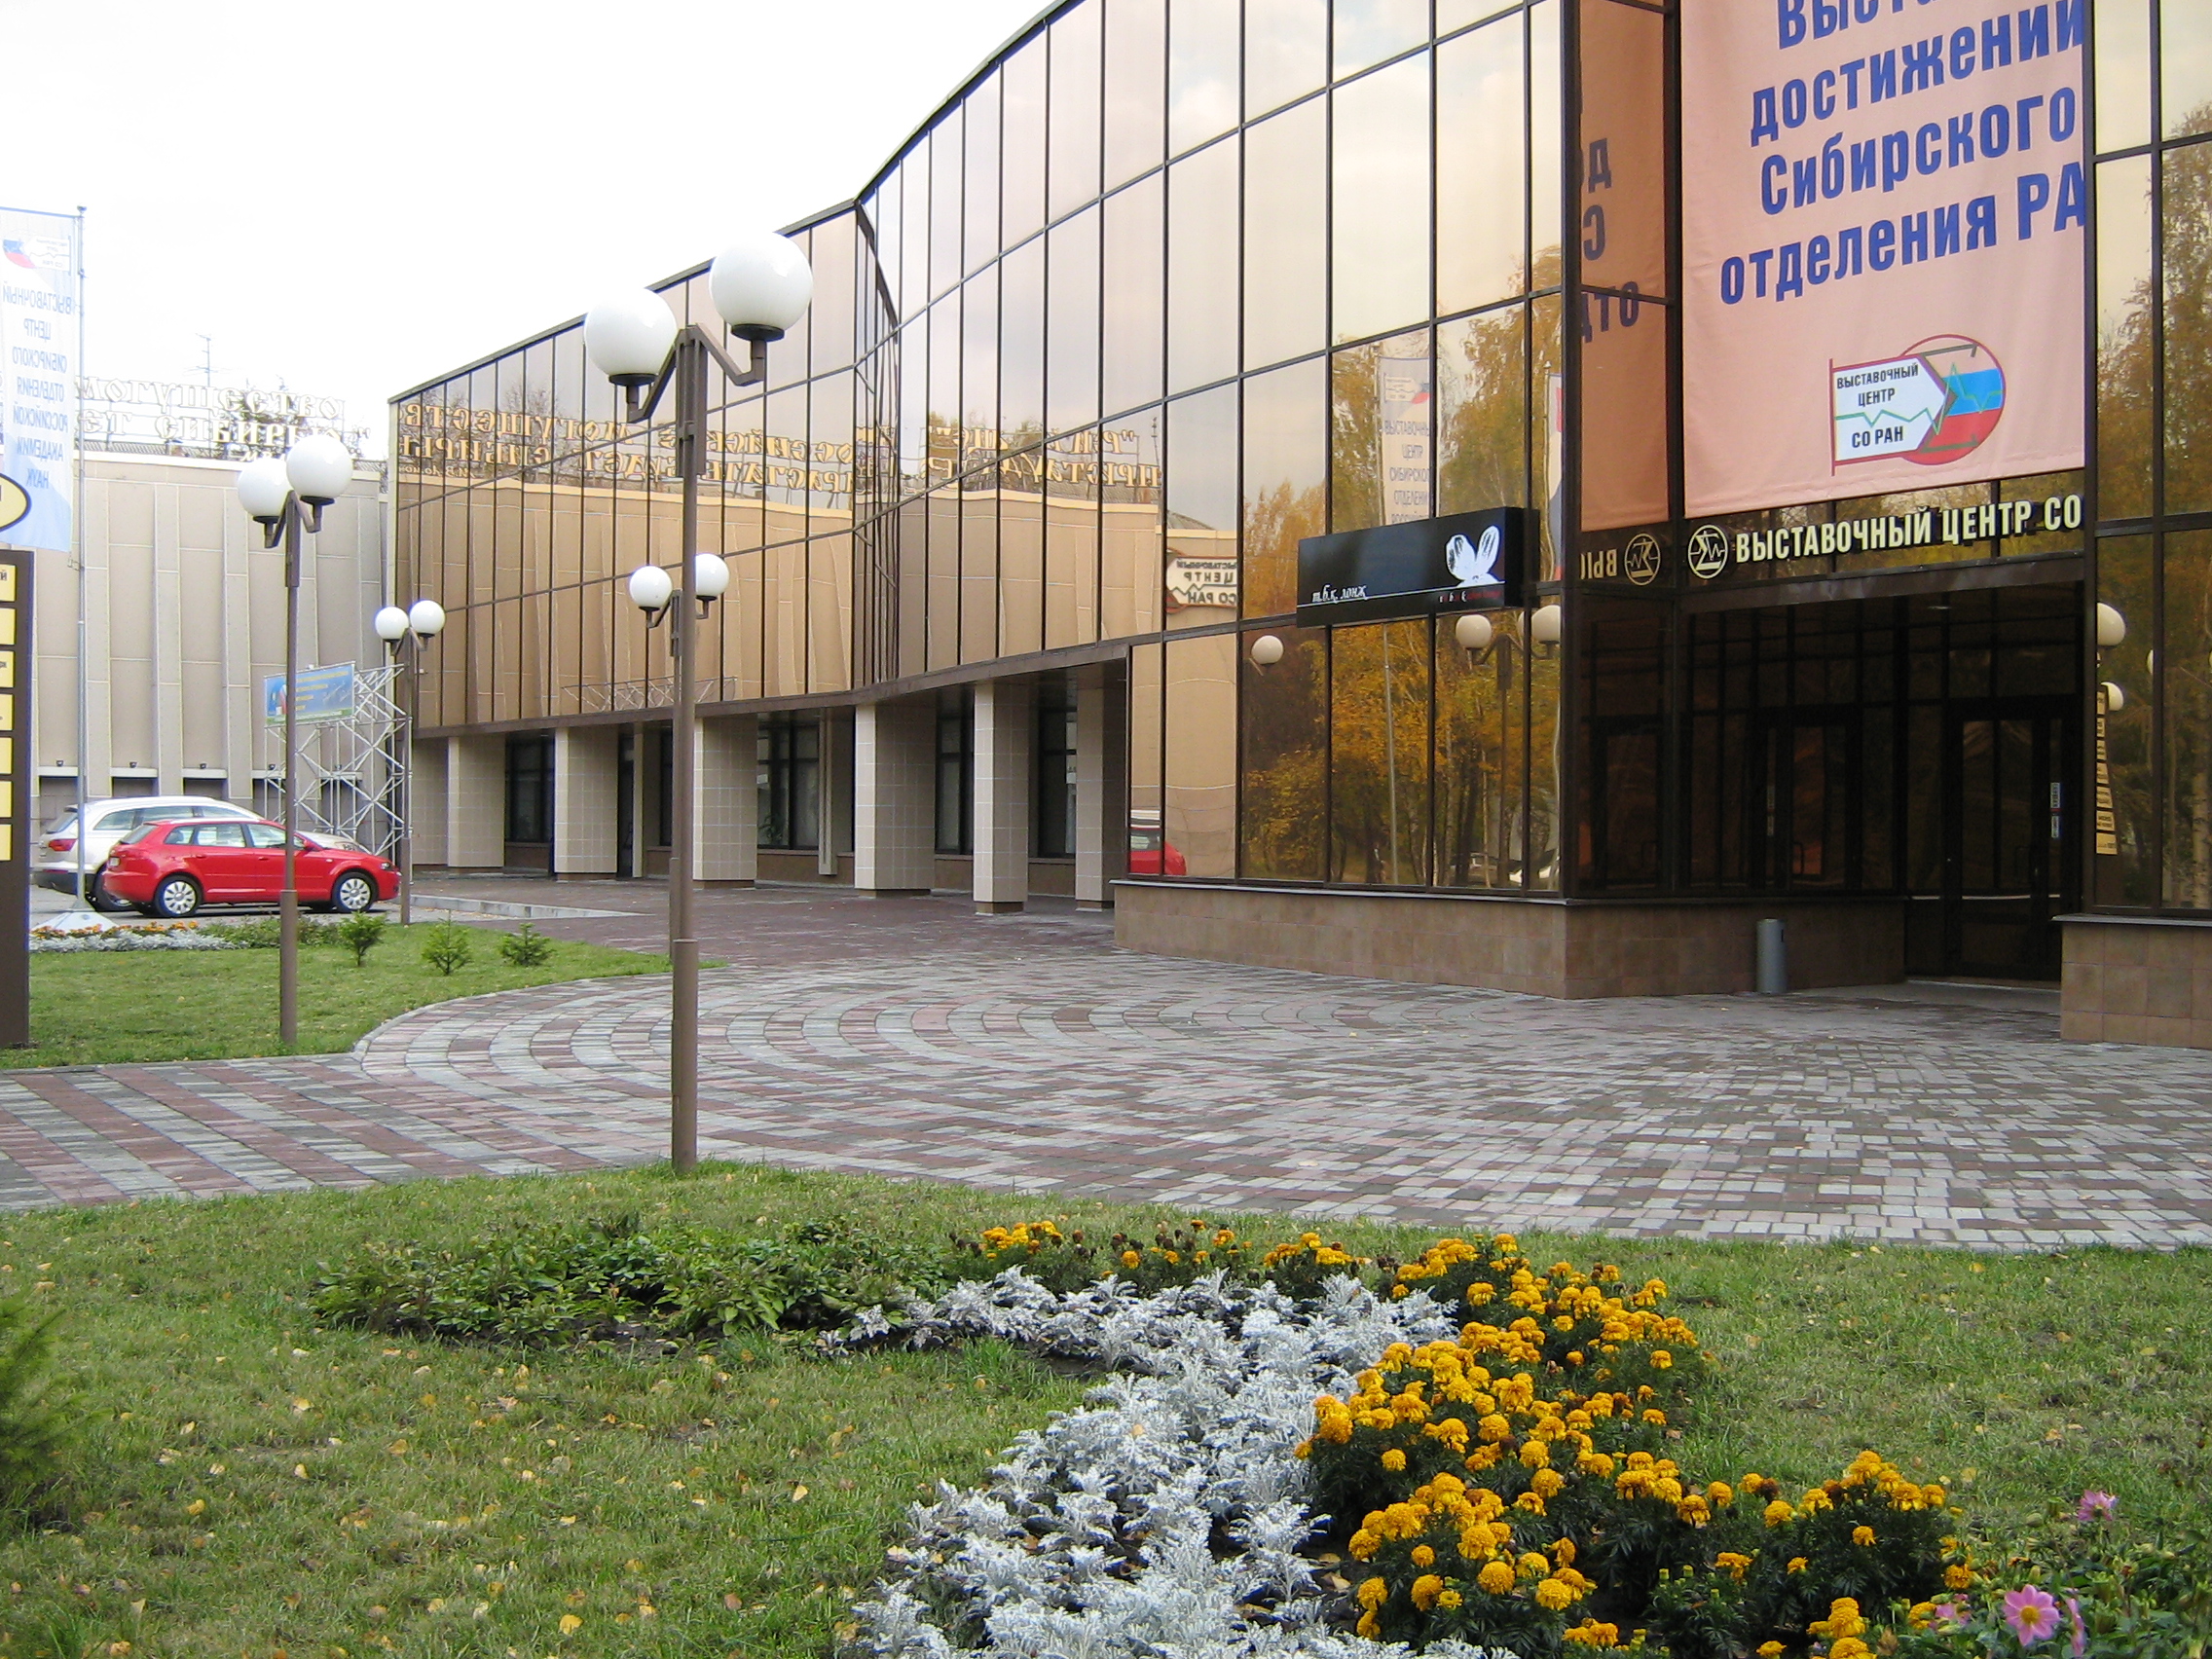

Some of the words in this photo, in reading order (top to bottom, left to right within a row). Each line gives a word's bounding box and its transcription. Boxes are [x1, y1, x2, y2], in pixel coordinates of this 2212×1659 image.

[1761, 88, 2076, 215] Сибирского
[1721, 195, 1997, 305] отделения
[2017, 162, 2085, 240] РА
[1836, 362, 1919, 389] ВЫСТАВОЧНЫЙ
[1858, 387, 1896, 408] ЦЕНТР
[1852, 430, 1870, 449] СО
[1874, 425, 1903, 445] РАН
[1736, 505, 1934, 565] ВЫСТАВОЧНЫЙ
[1942, 499, 2034, 546] ЦЕНТР
[2045, 494, 2083, 532] СО
